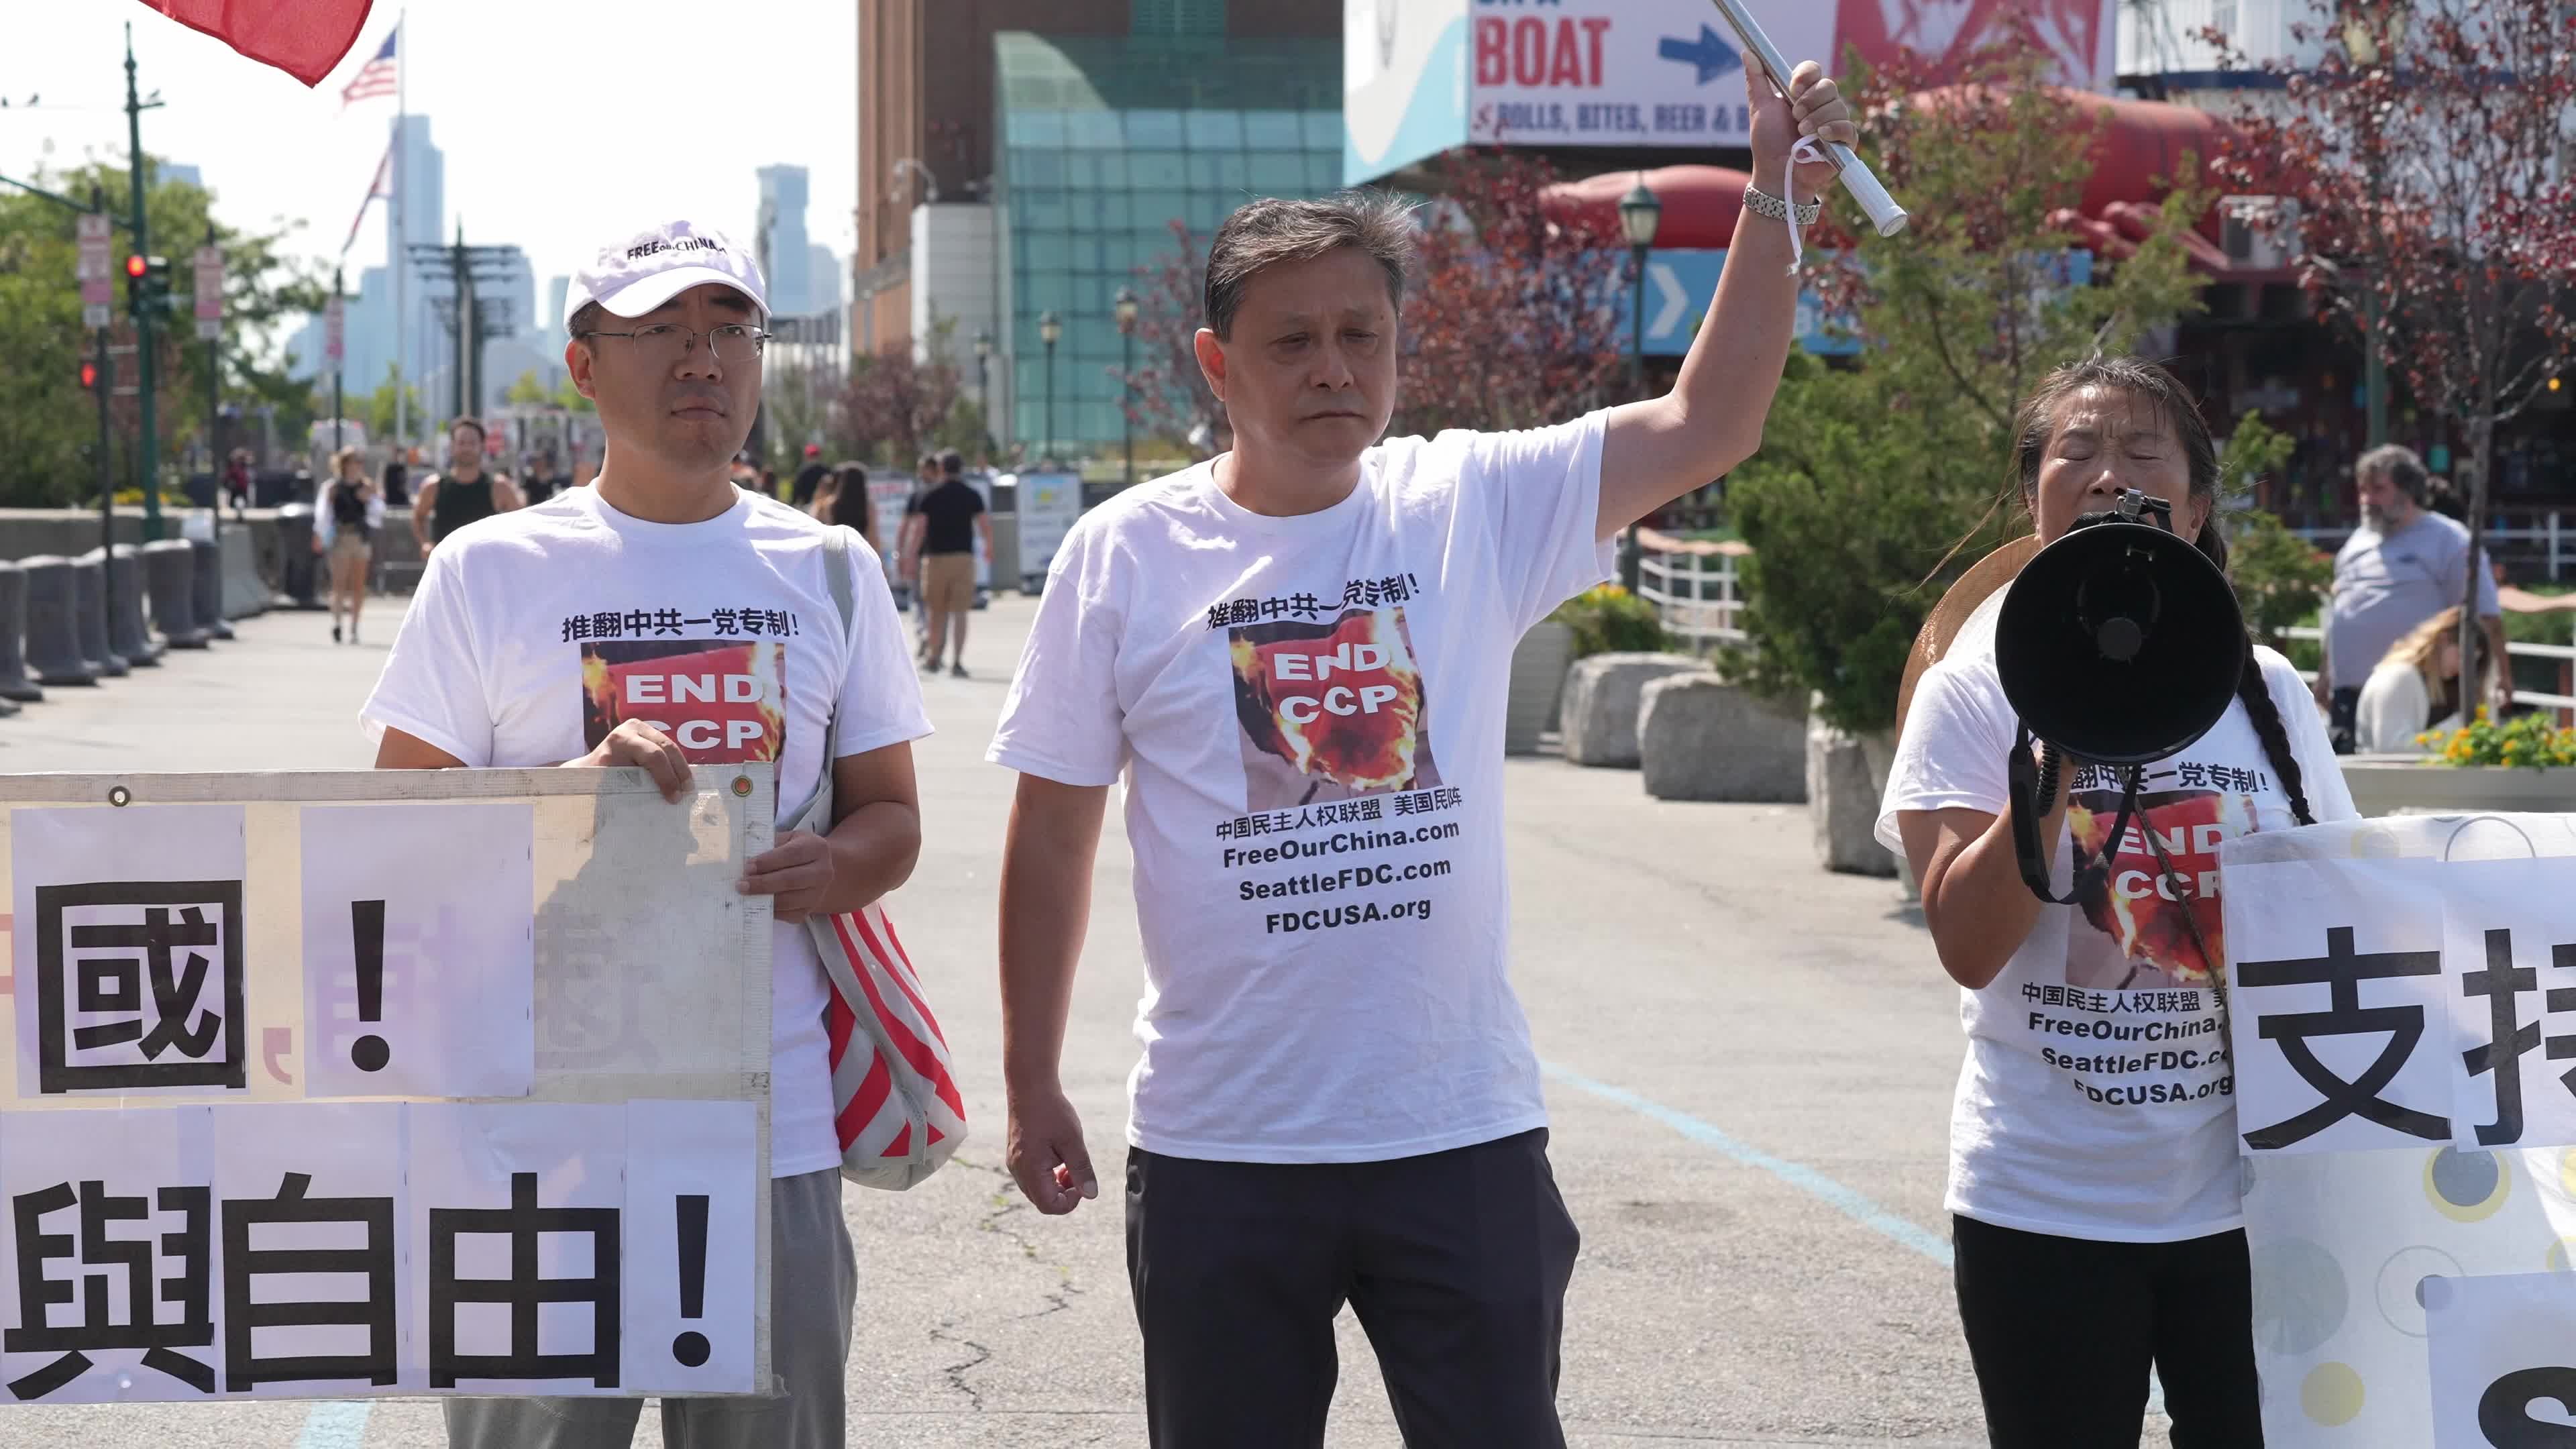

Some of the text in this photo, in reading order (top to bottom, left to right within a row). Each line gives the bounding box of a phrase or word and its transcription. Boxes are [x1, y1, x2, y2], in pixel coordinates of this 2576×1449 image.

[1477, 16, 1611, 87] BOAT
[1576, 103, 1647, 133] BITES,
[1654, 103, 1706, 133] BEER
[561, 608, 800, 643] 推翻中共一党专制!
[1274, 642, 1391, 681] END
[625, 674, 763, 704] END
[1279, 684, 1398, 724] CCP
[642, 719, 764, 750] CP
[1216, 798, 1383, 842] 中国民主人权联盟
[1223, 821, 1460, 868] FreeOurChina.com
[1239, 859, 1451, 901] SeattleFDC.com
[1266, 899, 1432, 934] FDCUSA.org
[2021, 982, 2201, 1014] 中国民主人权联盟
[4, 1171, 711, 1400] 與自由!
